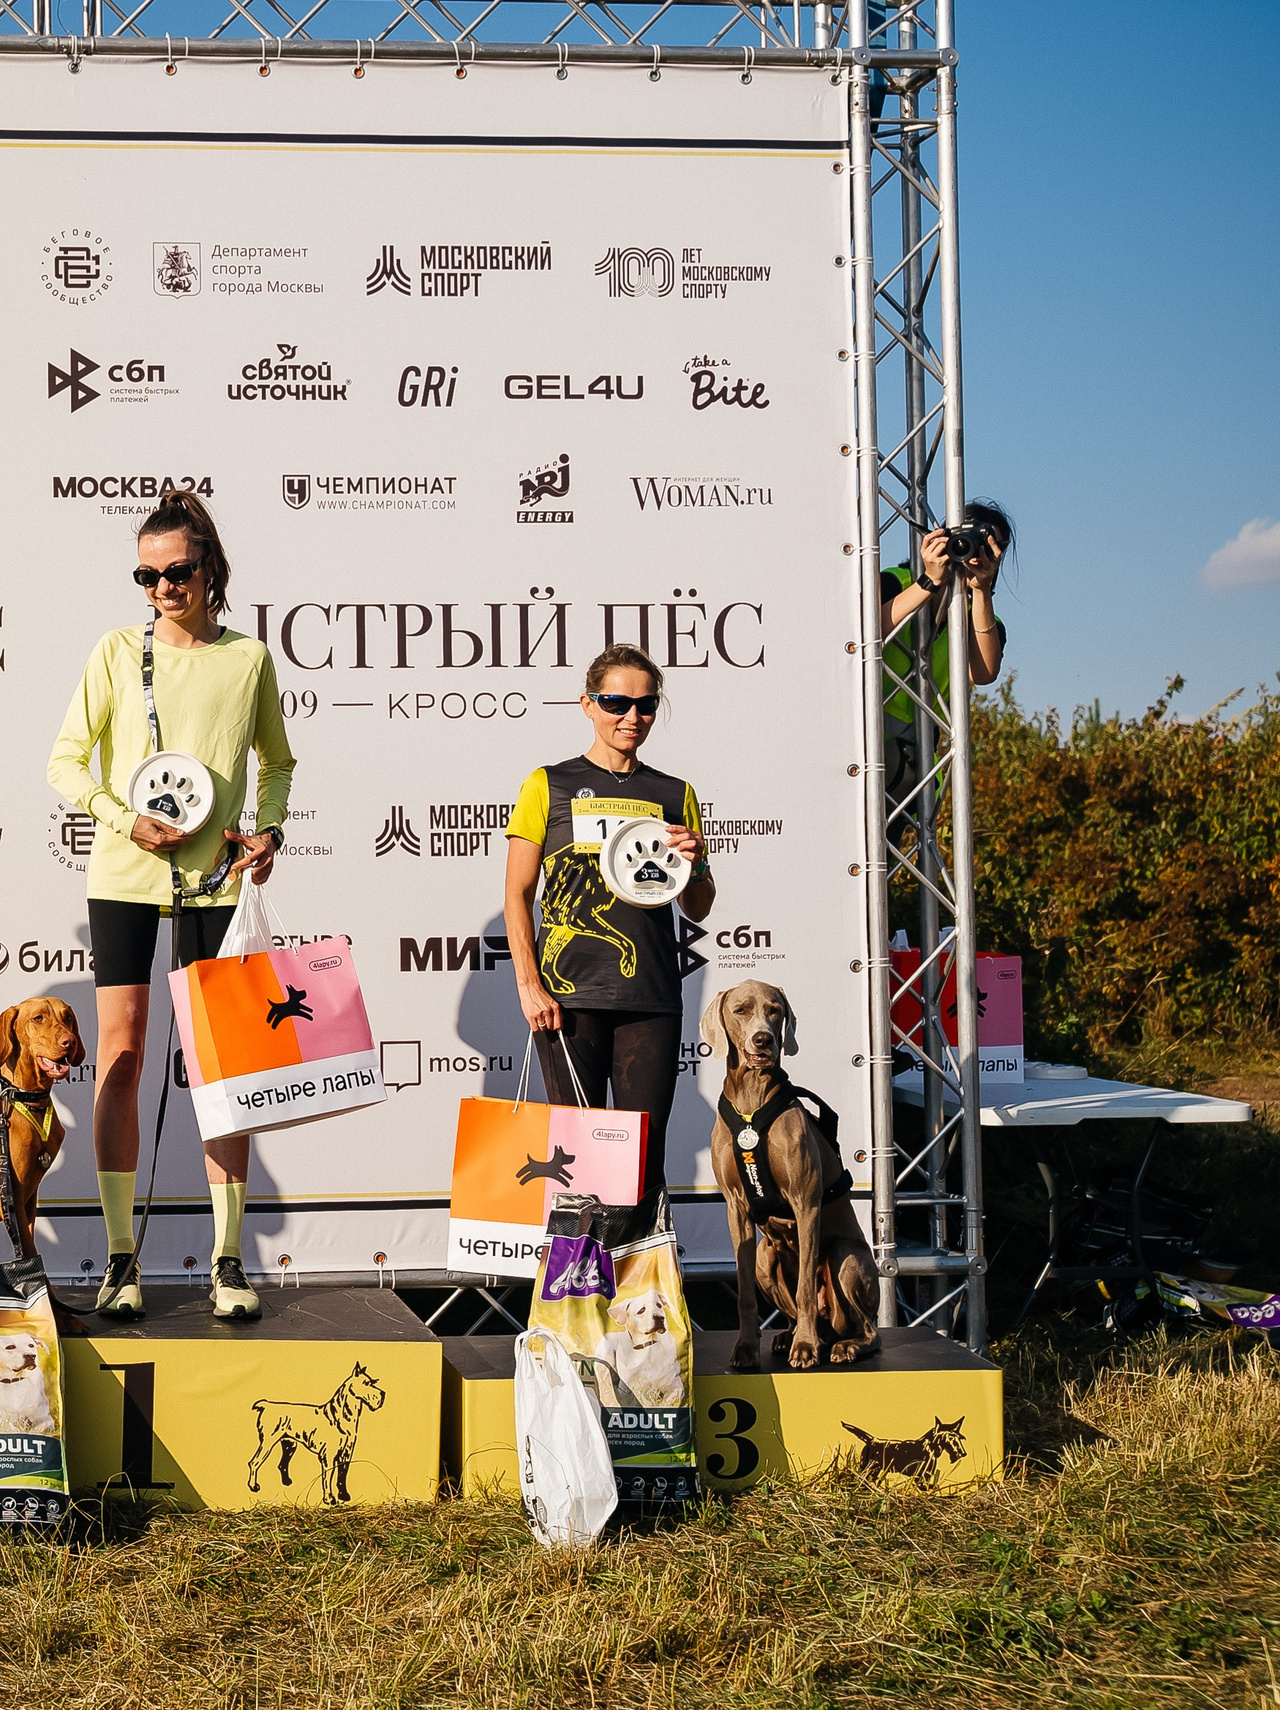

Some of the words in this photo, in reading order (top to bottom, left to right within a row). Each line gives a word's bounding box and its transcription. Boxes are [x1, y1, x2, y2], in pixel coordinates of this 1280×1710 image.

[43, 229, 111, 253] БЕГОВОЕ
[211, 244, 308, 260] Департамент
[421, 241, 552, 270] МОСКОВСКИЙ
[682, 248, 703, 264] ЛЕТ
[211, 264, 262, 278] спорта
[595, 247, 675, 298] 100
[682, 266, 772, 282] МОСКОВСКОМУ
[41, 274, 113, 306] СООБЩЕСТВО
[212, 282, 263, 297] города
[267, 280, 324, 294] Москвы
[421, 273, 482, 297] СПОРТ
[682, 284, 728, 299] СПОРТУ
[693, 354, 720, 368] take
[722, 358, 732, 367] a
[108, 358, 166, 383] сбп
[242, 359, 332, 383] святой
[109, 387, 143, 395] система
[145, 386, 180, 397] быстрых
[227, 382, 348, 402] источник
[397, 366, 459, 408] GRi
[504, 374, 644, 400] GEL4U
[691, 366, 771, 411] Bite
[109, 394, 149, 404] платежей
[519, 461, 558, 479] РАДИО
[53, 477, 215, 498] МОСКВА24
[317, 477, 457, 495] ЧЕМПИОНАТ
[100, 505, 158, 515] ТЕЛЕКАНА
[317, 500, 456, 510] WWW.CHAMPIONAT.COM
[517, 511, 573, 523] ENERGY
[597, 588, 766, 669] ПЁС
[388, 692, 528, 719] КРОСС
[700, 802, 714, 818] ЕТ
[703, 820, 783, 836] ОСКОВСКОМУ
[276, 844, 333, 856] Москвы
[431, 832, 492, 857] СПОРТ
[715, 925, 771, 949] сбп
[312, 957, 338, 969] 4lapy.ru
[400, 936, 512, 972] МИР
[717, 952, 750, 961] система
[751, 952, 786, 962] быстрых
[718, 960, 757, 969] платежей
[428, 1052, 514, 1073] mos.ru
[236, 1080, 317, 1110] четыре
[322, 1068, 376, 1095] лапы
[596, 1131, 625, 1141] 4lapy.ru
[97, 1361, 176, 1490] 1
[607, 1412, 677, 1430] ADULT
[706, 1396, 759, 1480] 3
[40, 1478, 49, 1486] 12
